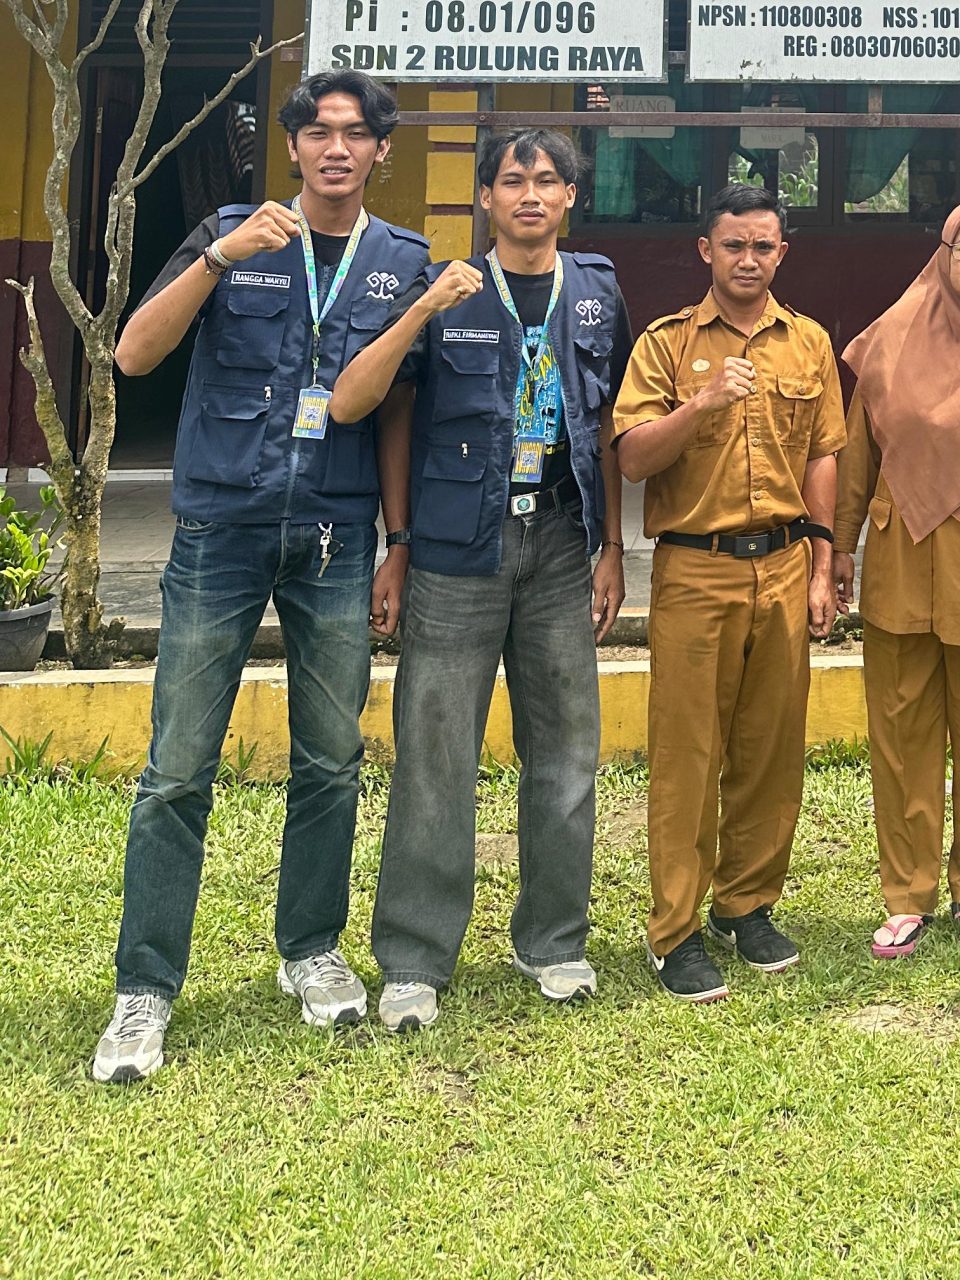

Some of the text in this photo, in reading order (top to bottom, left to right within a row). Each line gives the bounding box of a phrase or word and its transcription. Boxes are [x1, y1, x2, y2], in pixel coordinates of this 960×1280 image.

[346, 0, 377, 31] Pi
[426, 0, 595, 33] 08.01/096
[699, 5, 746, 26] NPSN
[760, 6, 861, 27] 110800308
[883, 7, 917, 28] NSS
[784, 36, 817, 56] REG
[332, 45, 643, 71] SDN 2 RULUNG RAYA
[235, 274, 287, 285] RANGGA WAHYU
